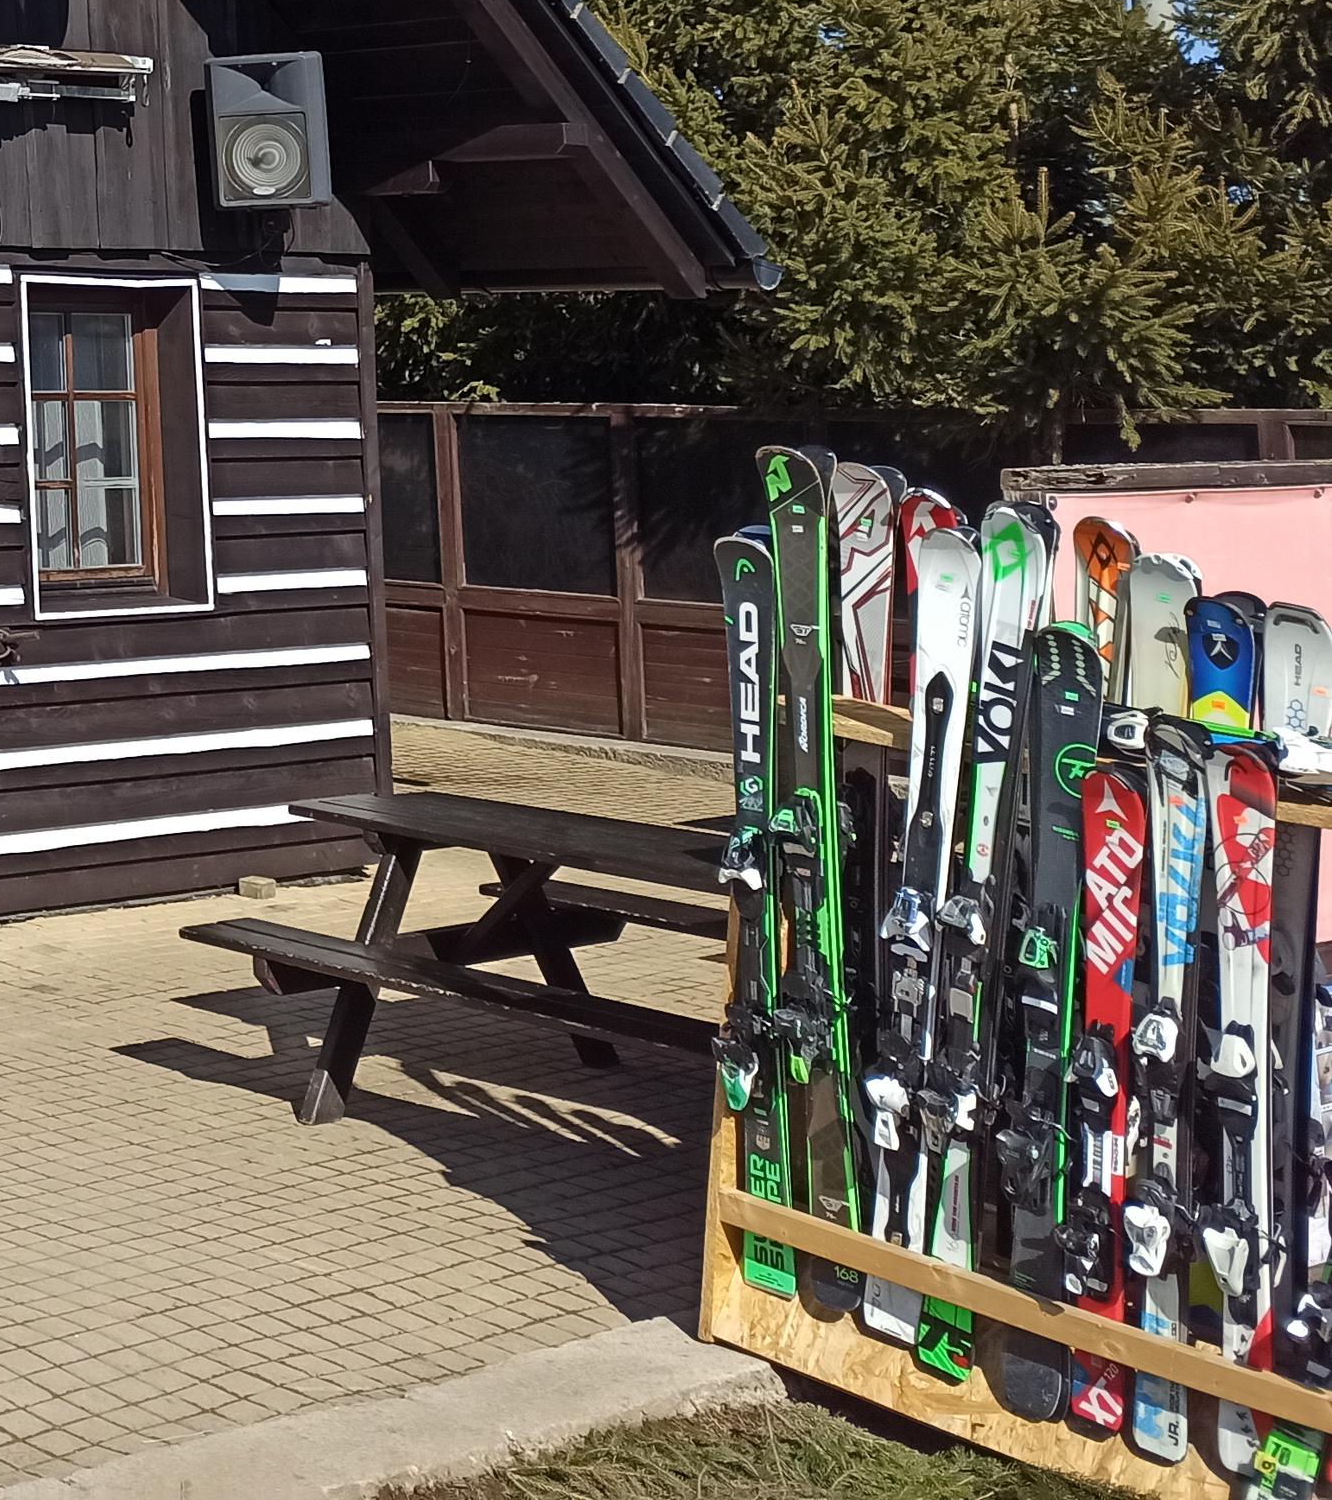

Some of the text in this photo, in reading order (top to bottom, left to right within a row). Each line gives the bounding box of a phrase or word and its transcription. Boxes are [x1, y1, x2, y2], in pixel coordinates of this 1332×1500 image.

[738, 601, 761, 764] HEAD
[1294, 643, 1303, 687] HEAD
[1086, 828, 1144, 911] ATO
[1086, 886, 1138, 975] MIC
[833, 1265, 859, 1284] 168
[1102, 1363, 1119, 1382] 120
[1168, 1420, 1179, 1447] JR.
